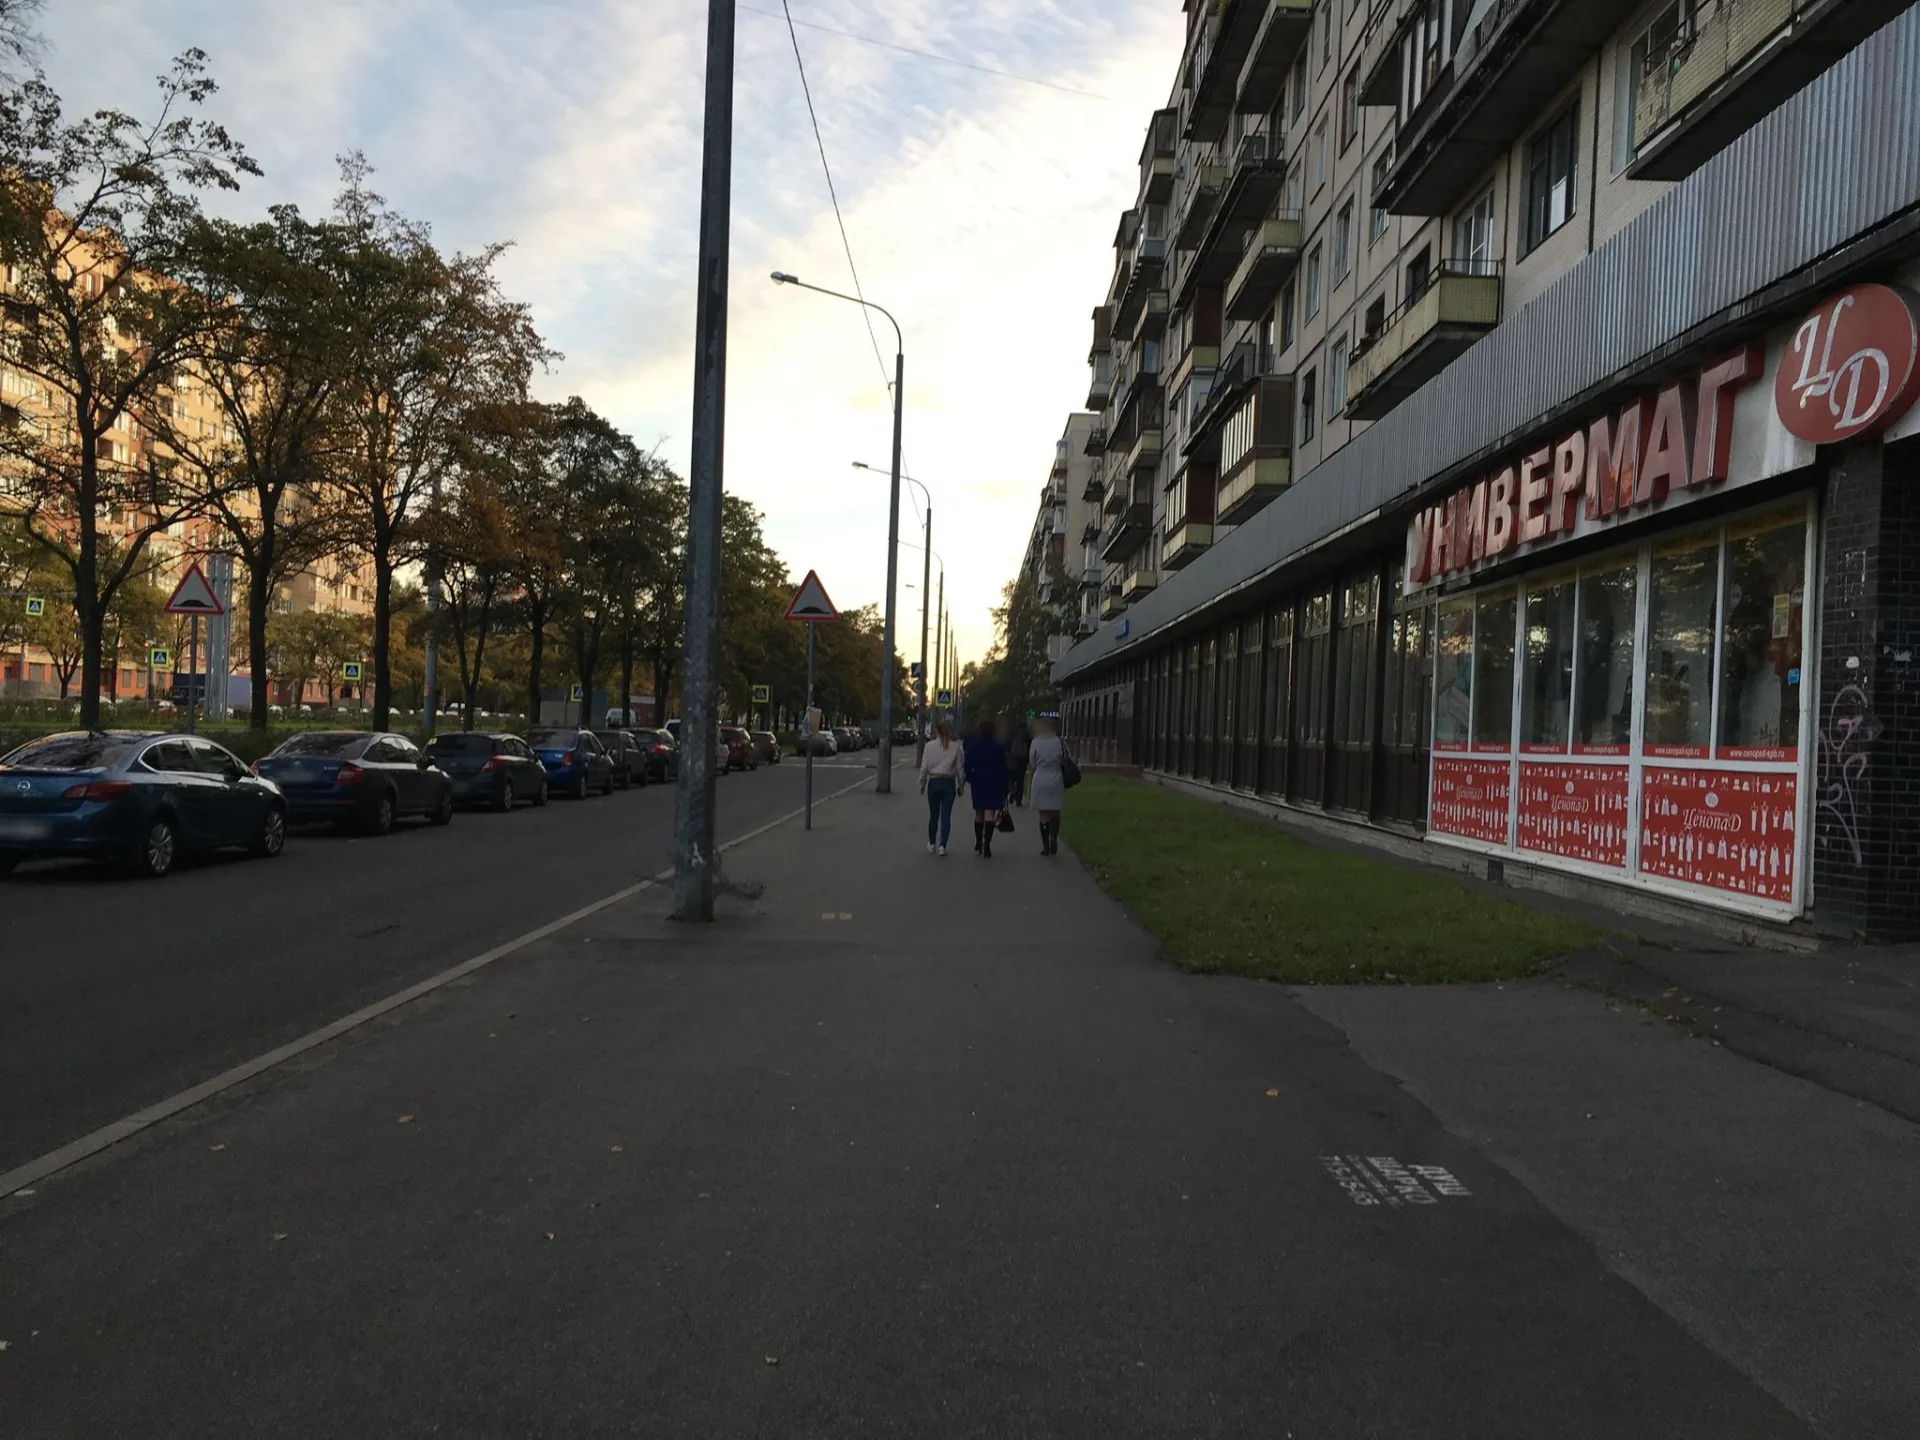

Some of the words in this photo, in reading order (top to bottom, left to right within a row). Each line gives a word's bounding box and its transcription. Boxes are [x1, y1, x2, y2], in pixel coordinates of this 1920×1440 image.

[1411, 345, 1764, 583] УНИВЕРМАГ
[1654, 747, 1700, 758] www.cenopad-spb.ru
[1729, 749, 1785, 761] www.cenopad-spb.ru
